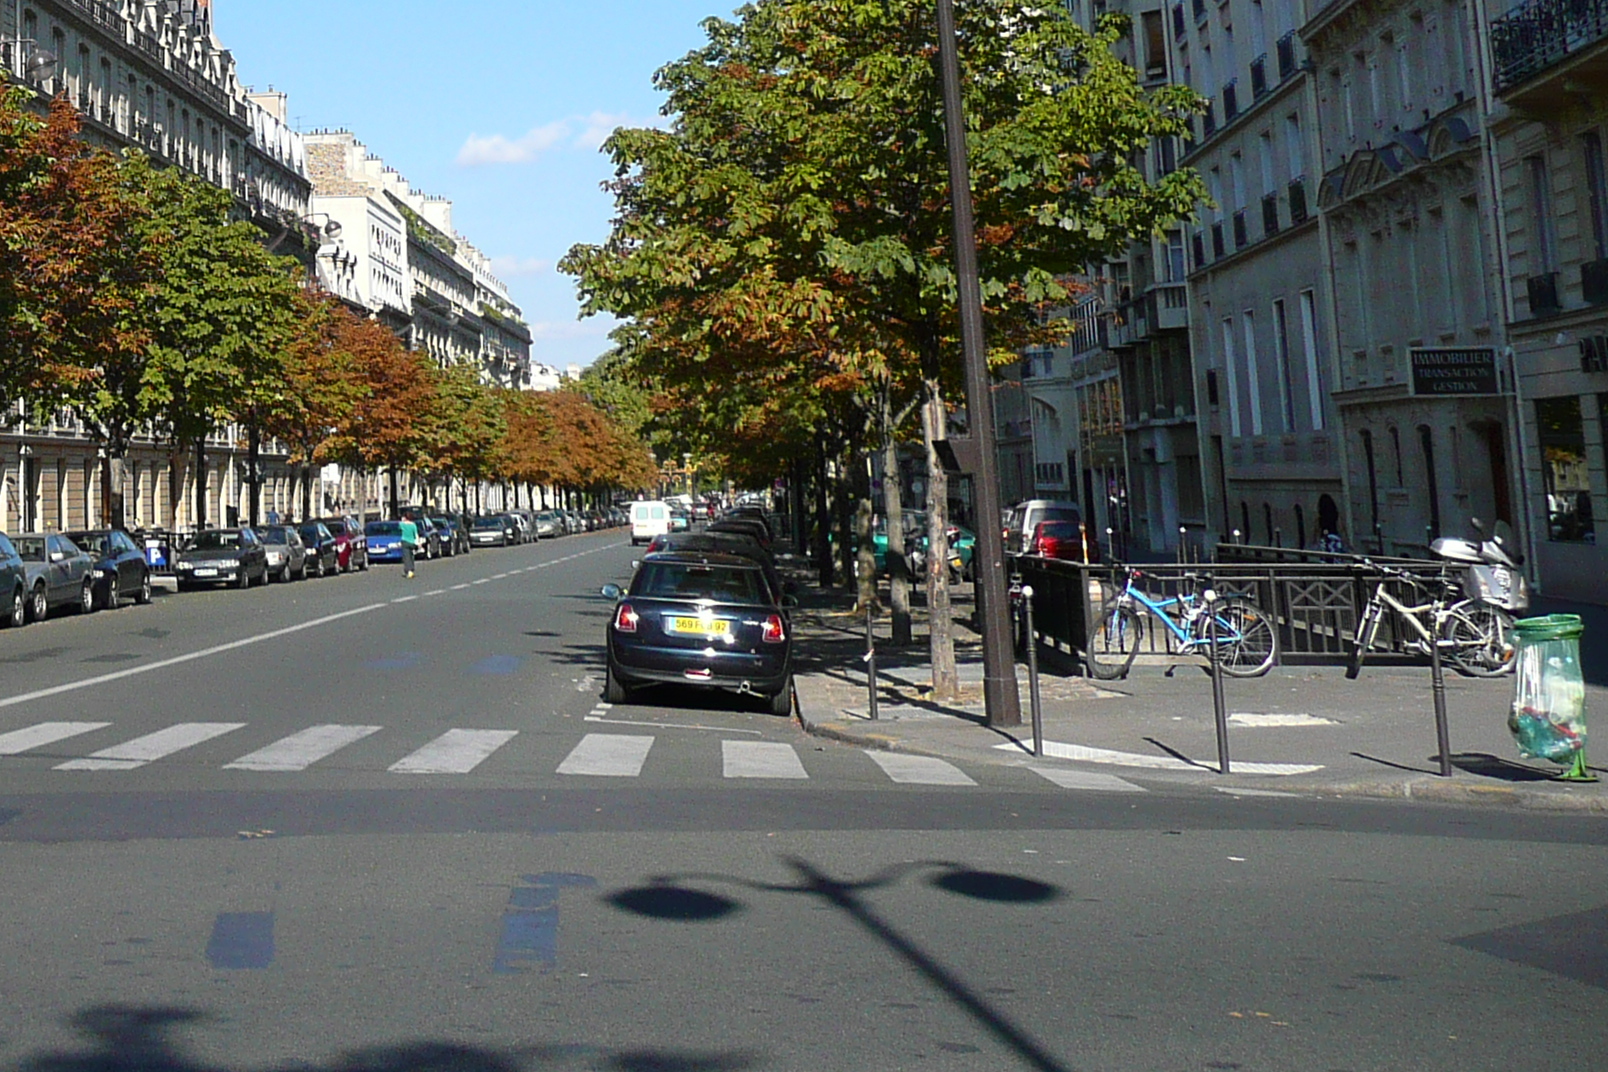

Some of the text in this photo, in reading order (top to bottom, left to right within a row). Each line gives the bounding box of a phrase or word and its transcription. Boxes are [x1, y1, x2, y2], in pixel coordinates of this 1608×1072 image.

[1413, 351, 1492, 365] IMMOBILIER
[1418, 367, 1489, 379] TRANSACTION
[1433, 381, 1478, 392] GESTION
[151, 548, 161, 563] P
